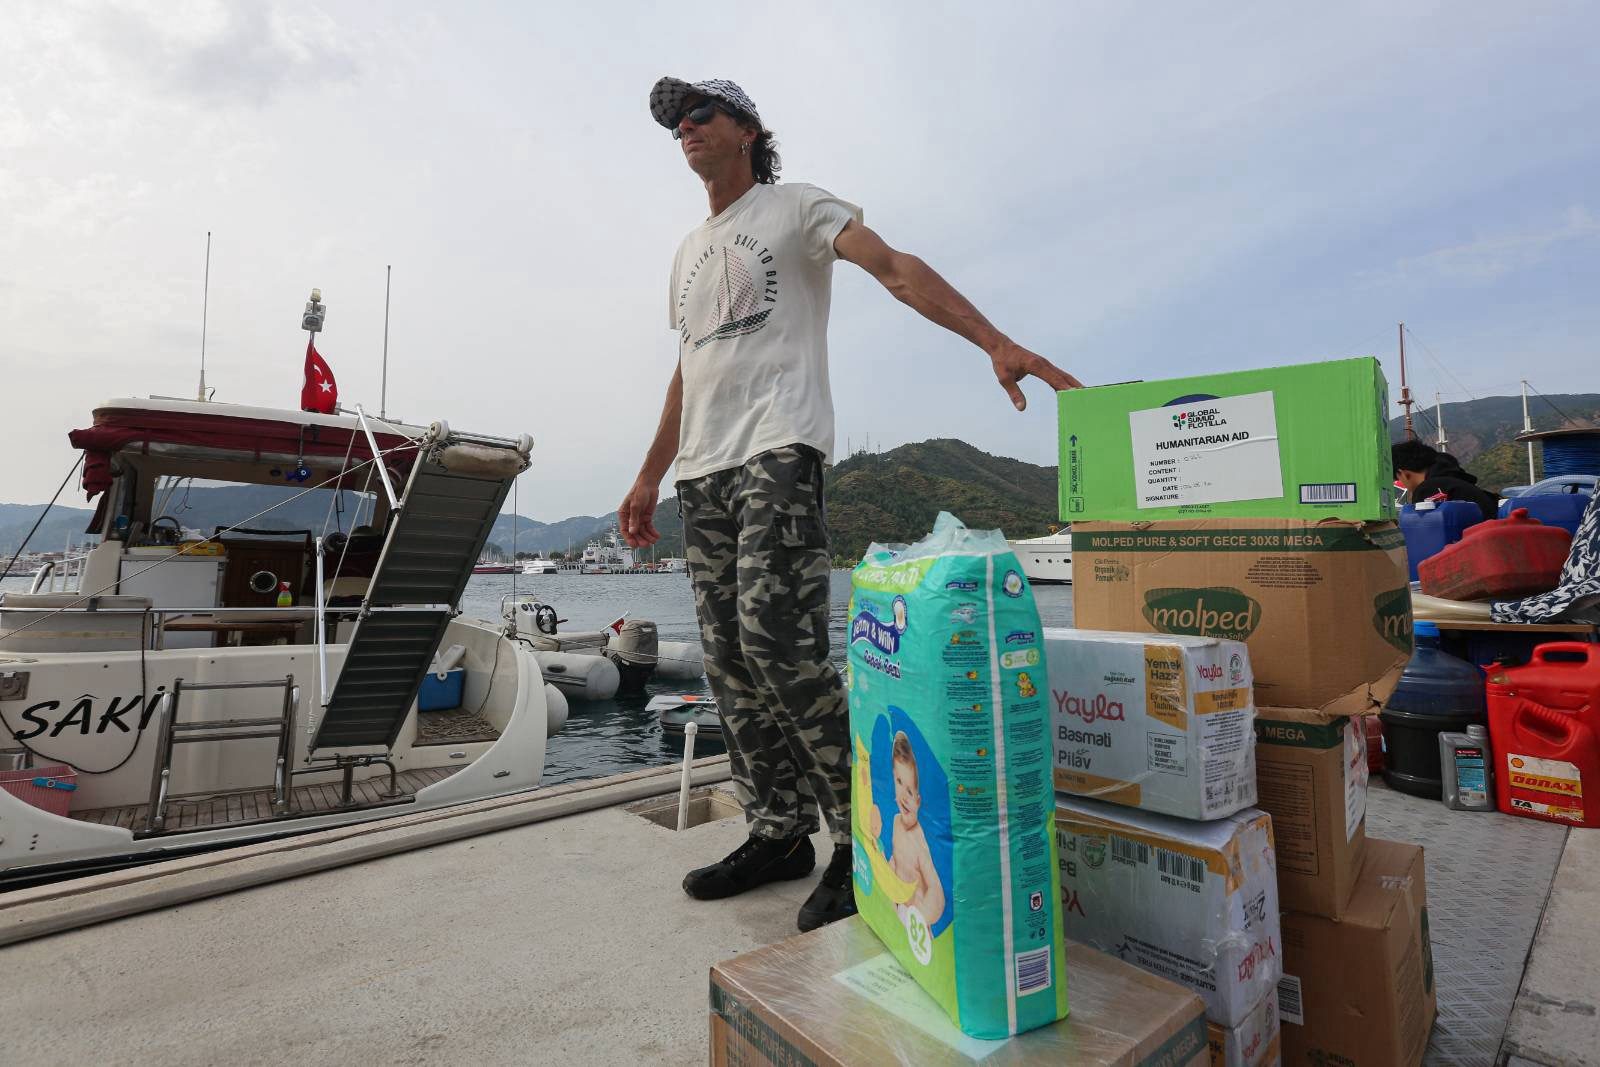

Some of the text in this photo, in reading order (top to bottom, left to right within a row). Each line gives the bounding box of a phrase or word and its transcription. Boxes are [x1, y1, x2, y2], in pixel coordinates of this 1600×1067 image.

[734, 234, 758, 251] SAIL
[757, 248, 773, 265] TO
[679, 245, 715, 307] PALESTINE
[1187, 408, 1220, 418] GLOBAL
[1187, 415, 1215, 423] SUMUD
[1188, 419, 1227, 430] FLOTILLA
[1156, 431, 1249, 450] HUMANITARIAN AID
[1145, 494, 1179, 502] SIGNATURE
[1092, 535, 1323, 547] MOLPED PURE & SOFT GECE 30X8 MEGA
[1153, 597, 1254, 636] molped
[878, 625, 895, 655] Willy
[1004, 654, 1013, 666] 5
[1145, 658, 1182, 670] Yemek
[1196, 664, 1223, 681] Yayla
[1052, 689, 1125, 724] Yayla
[1058, 726, 1112, 748] Basmati
[1265, 727, 1307, 742] MEGA
[1058, 750, 1092, 770] Pilav
[1513, 799, 1533, 809] TA
[910, 912, 928, 955] 82
